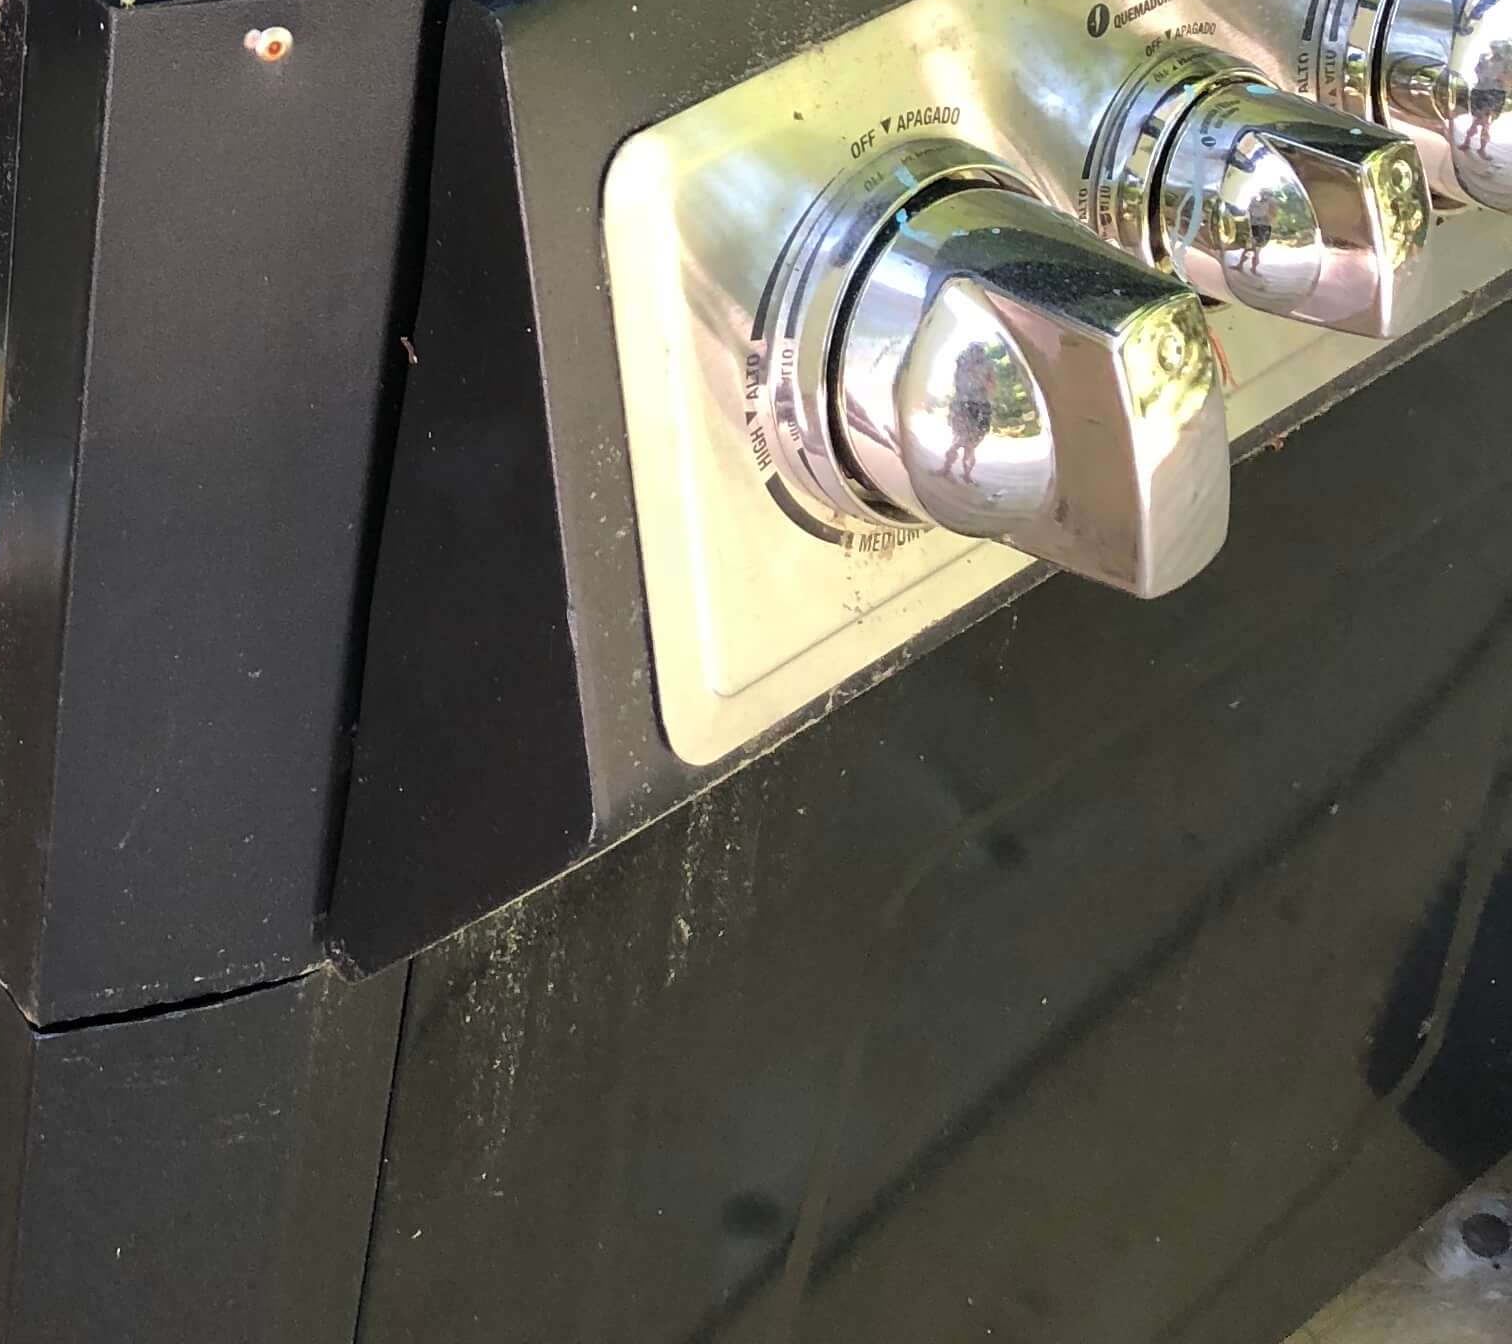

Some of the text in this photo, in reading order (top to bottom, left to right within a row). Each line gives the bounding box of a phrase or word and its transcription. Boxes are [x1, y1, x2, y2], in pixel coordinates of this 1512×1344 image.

[1145, 21, 1217, 57] OFF APAGADO
[1297, 52, 1309, 94] ALTO
[850, 106, 961, 159] OFF APAGADO
[745, 354, 772, 472] HIGH ALTO
